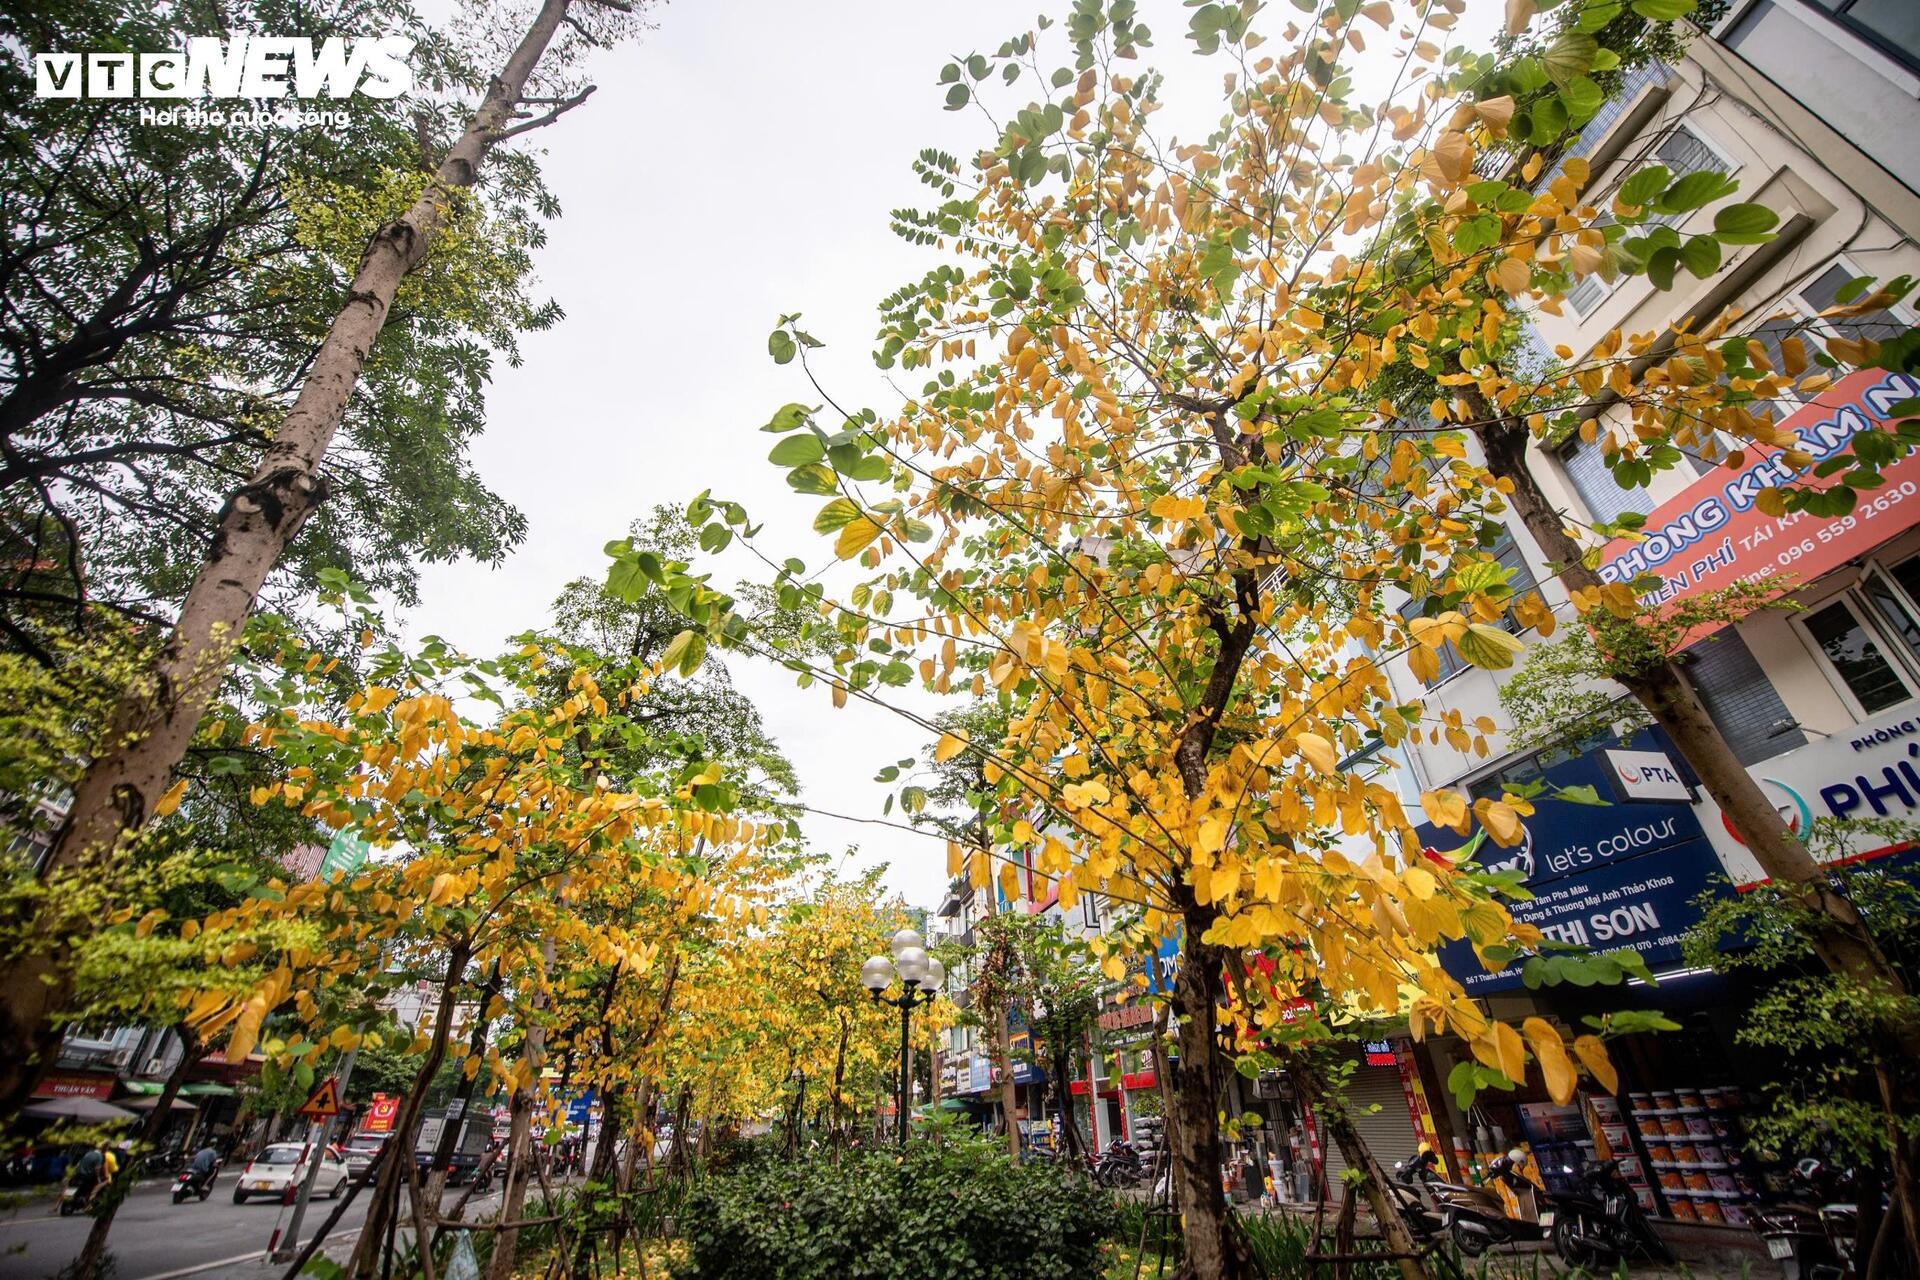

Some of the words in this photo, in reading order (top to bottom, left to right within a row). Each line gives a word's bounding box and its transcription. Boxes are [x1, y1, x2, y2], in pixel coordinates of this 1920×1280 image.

[1777, 538, 1816, 566] 096
[1816, 514, 1857, 544] 559
[1859, 480, 1918, 520] 2630
[1691, 536, 1737, 583] PHÍ
[1739, 525, 1774, 552] TÁI
[1850, 719, 1915, 752] PHÒNG
[1640, 766, 1679, 784] PTA
[1597, 816, 1676, 858] colour
[1509, 899, 1534, 913] Trung
[1552, 887, 1569, 901] Pha
[1544, 907, 1553, 917] &
[1602, 889, 1621, 902] Anh
[1647, 875, 1675, 891] Khoa
[1589, 901, 1661, 941] SƠN
[1636, 940, 1653, 952] 070
